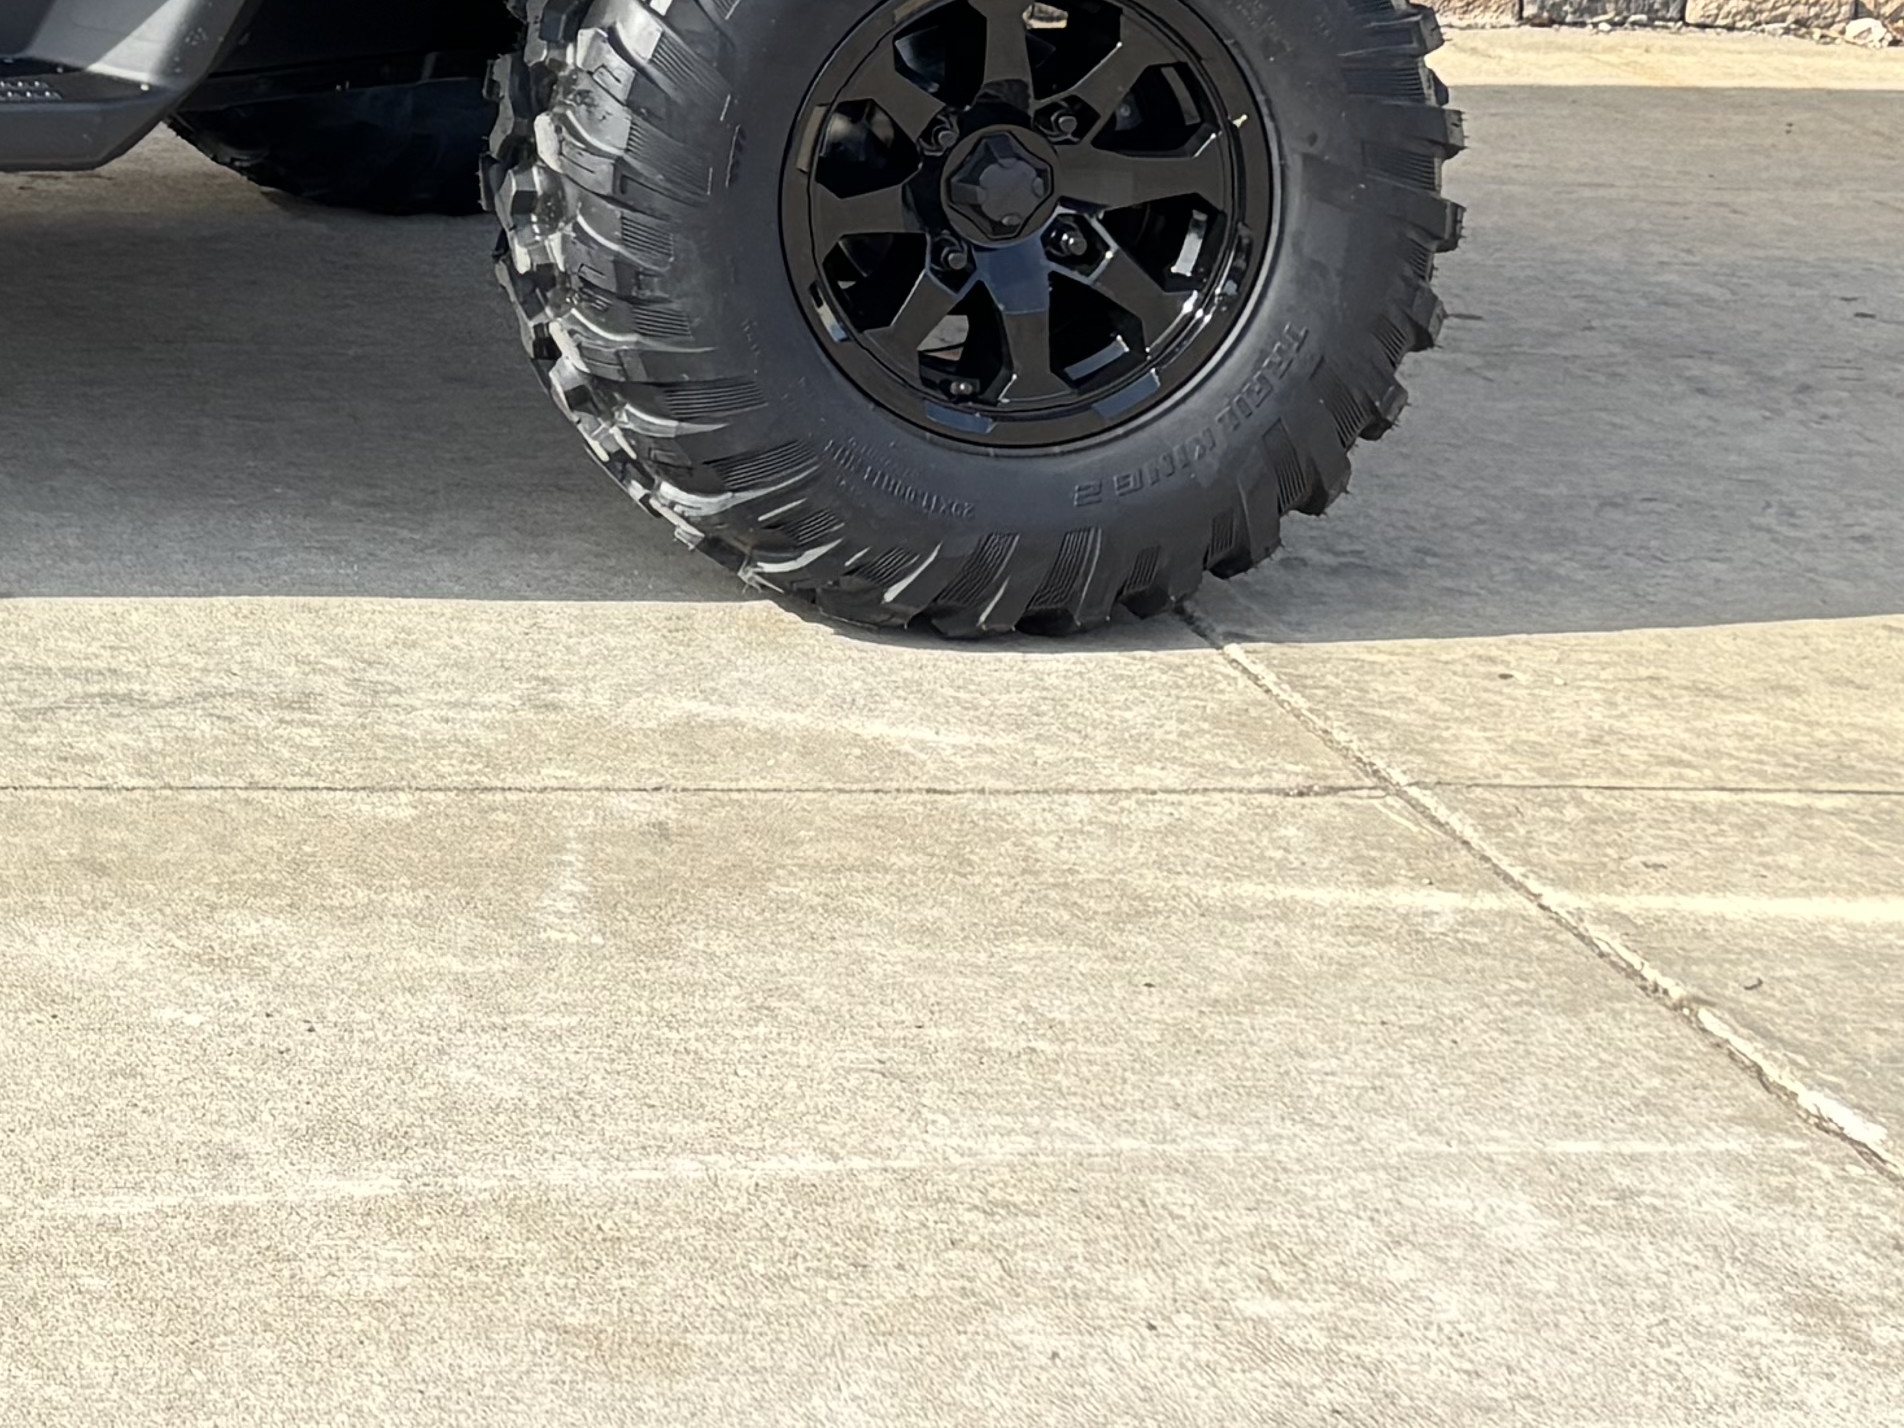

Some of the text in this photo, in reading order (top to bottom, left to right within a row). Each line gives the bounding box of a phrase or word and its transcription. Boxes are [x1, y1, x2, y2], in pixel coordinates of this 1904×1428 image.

[1071, 320, 1310, 509] TRAIL KING 2
